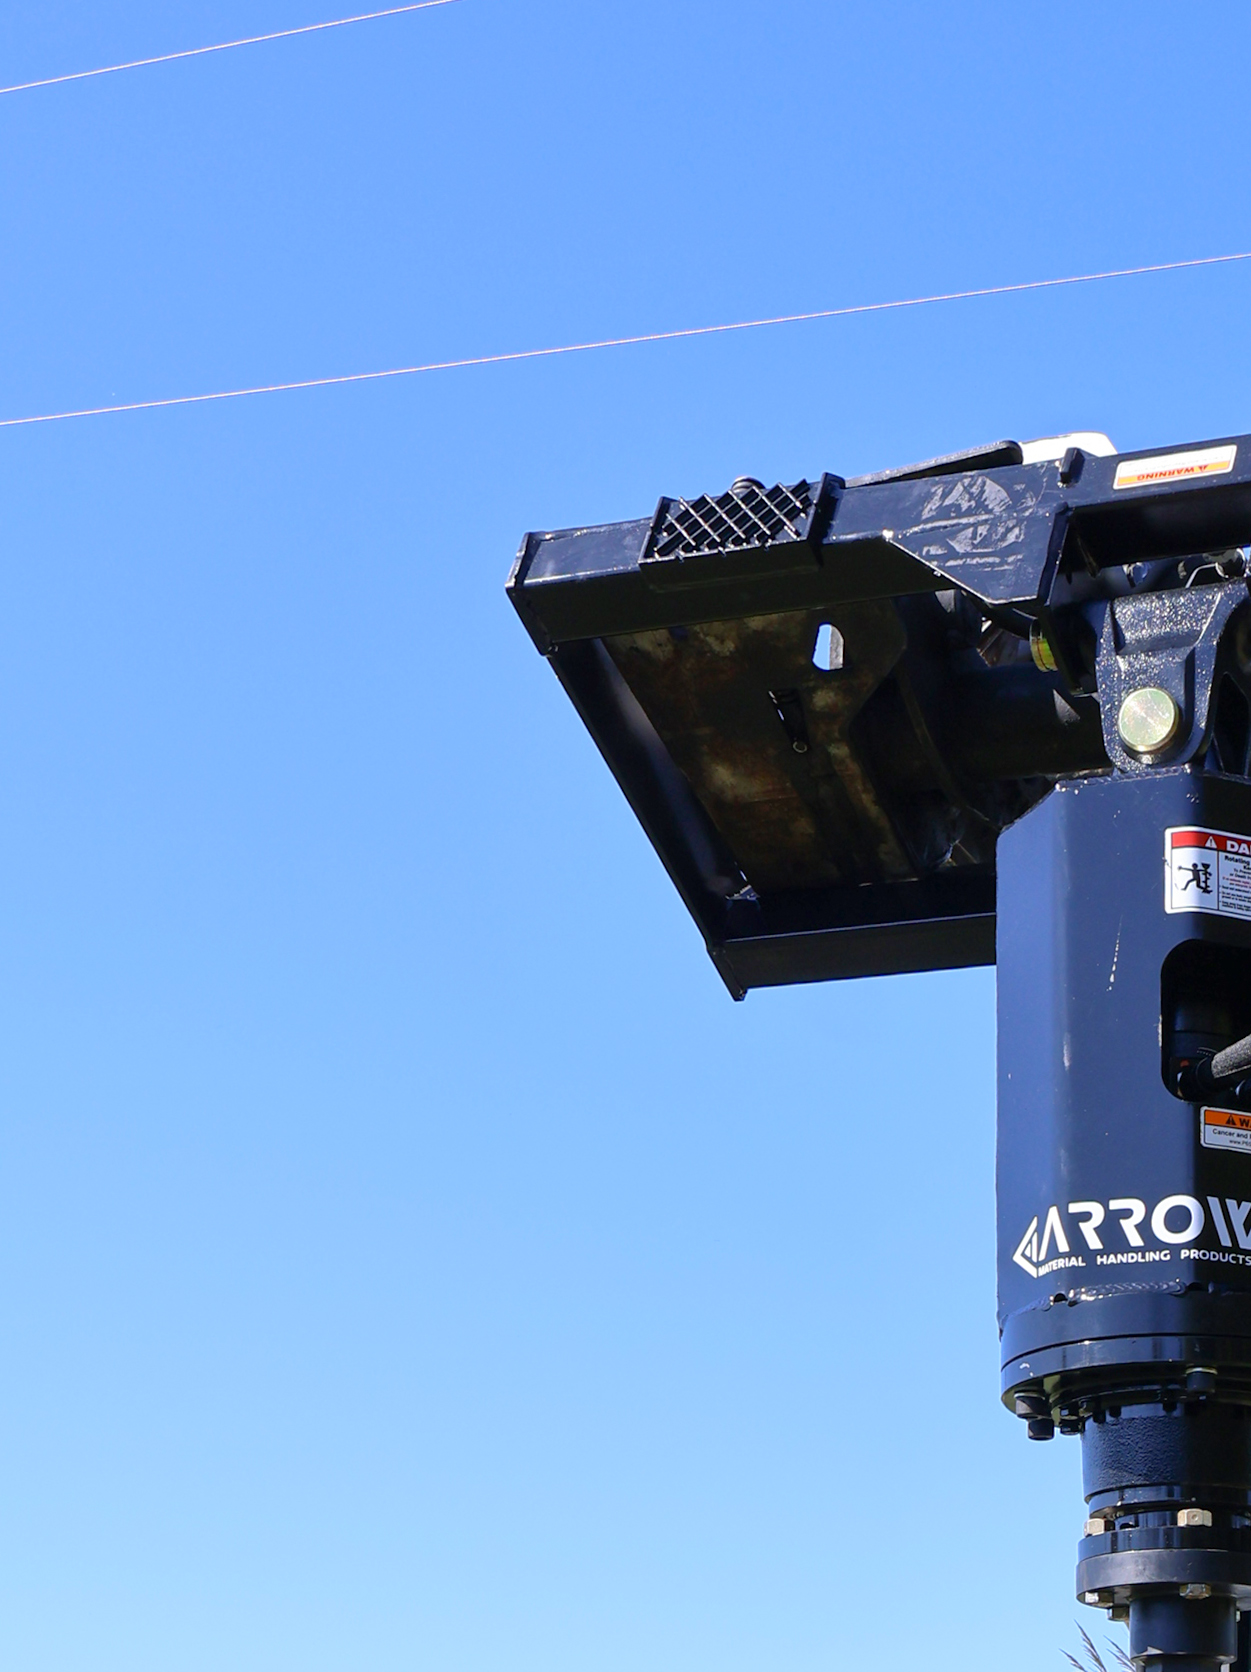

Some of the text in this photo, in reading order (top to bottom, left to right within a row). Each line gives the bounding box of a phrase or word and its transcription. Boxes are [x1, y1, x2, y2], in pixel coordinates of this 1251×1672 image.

[1137, 465, 1195, 481] WARNING
[1225, 855, 1250, 866] Rotating
[1212, 1128, 1235, 1137] Cancer
[1236, 1131, 1248, 1140] and
[1037, 1254, 1087, 1277] MATERIAL
[1096, 1249, 1171, 1266] HANDLING
